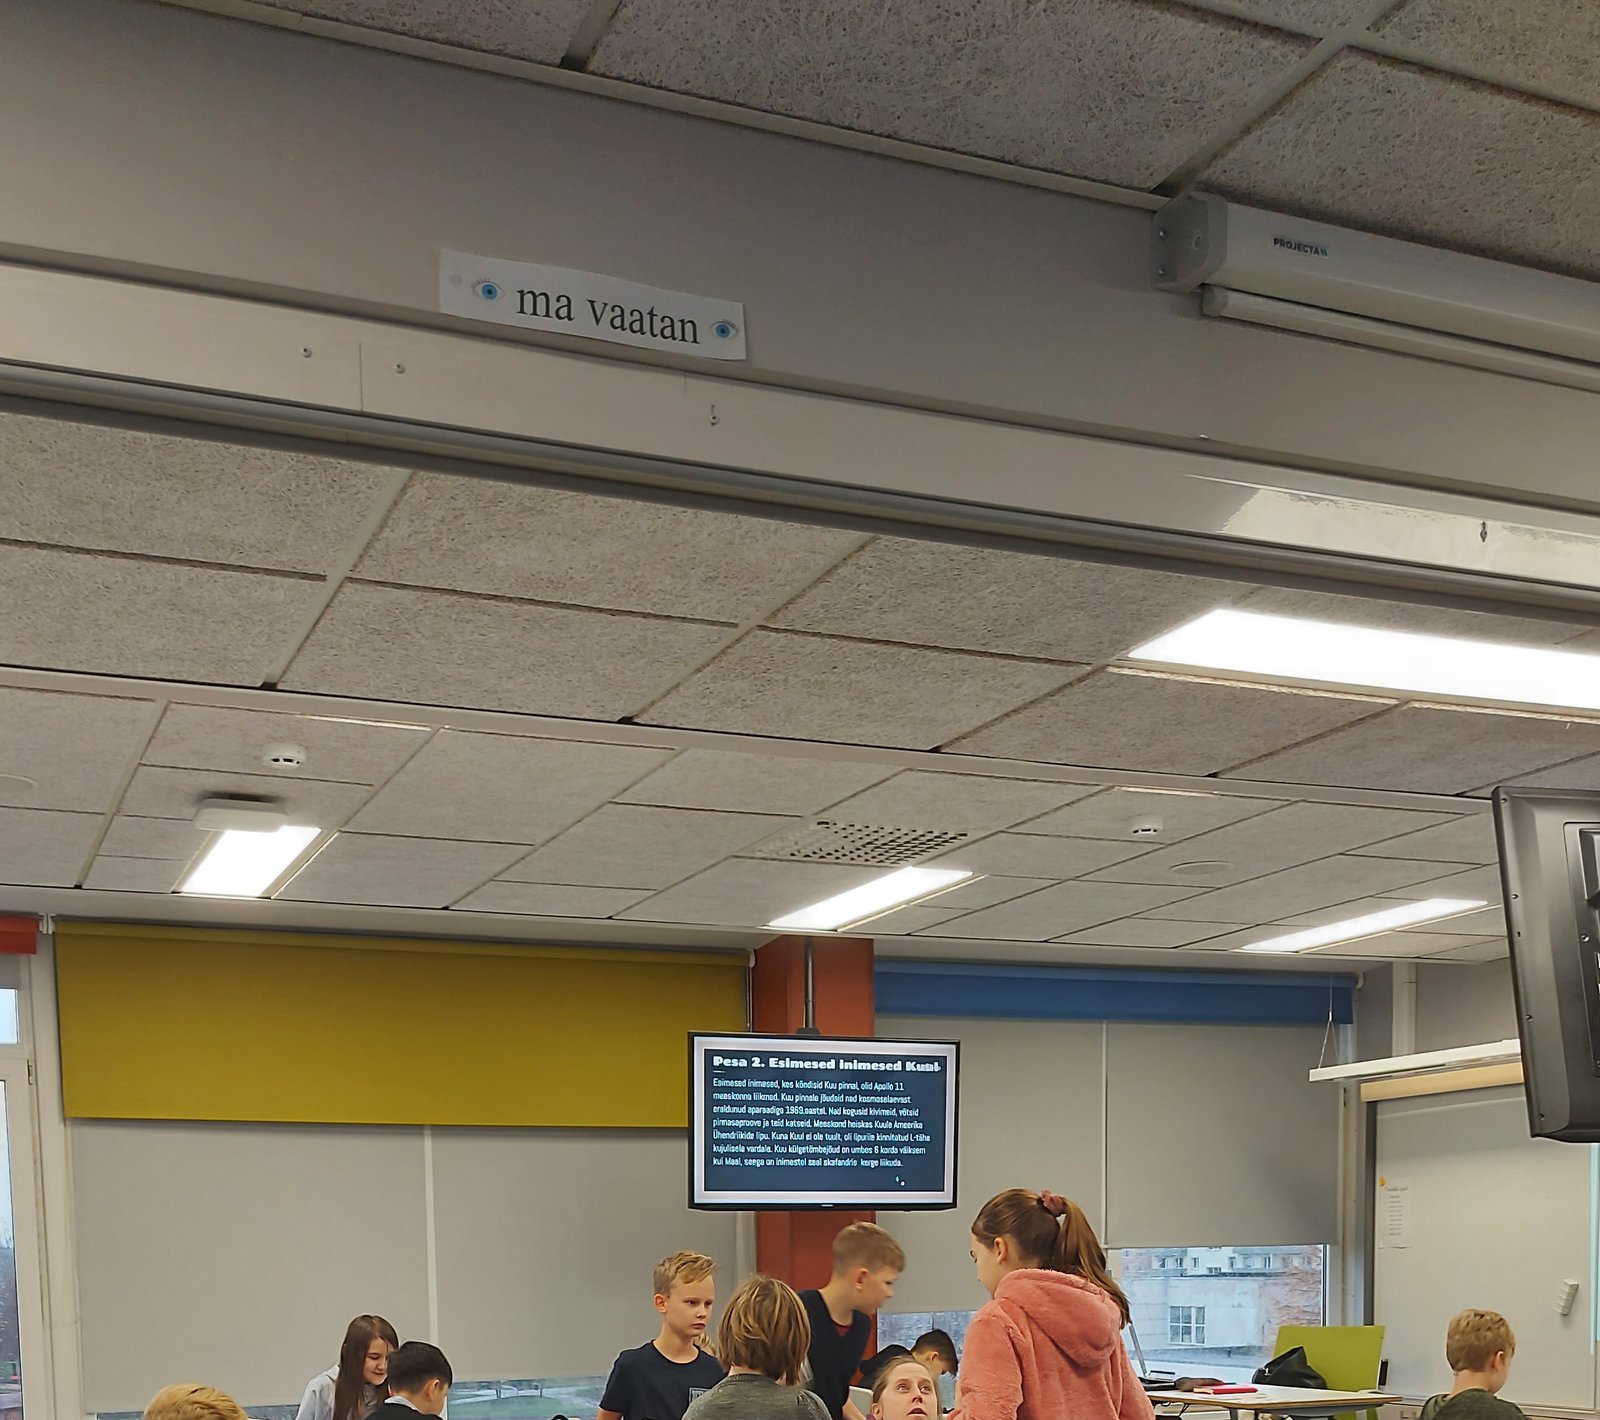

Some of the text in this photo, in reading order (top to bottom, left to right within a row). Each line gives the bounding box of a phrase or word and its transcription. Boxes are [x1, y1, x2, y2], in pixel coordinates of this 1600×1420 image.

[516, 289, 701, 345] ma vaatan
[713, 1056, 748, 1067] Pesa
[751, 1057, 766, 1068] 2.
[769, 1057, 835, 1070] Esimesed
[839, 1059, 902, 1071] inimesed
[713, 1078, 905, 1092] Esimesed inimesed, kes kõndisid Kuu pinnal, olid Apollo 11
[713, 1091, 911, 1104] meeskonna liikmed. Kuu pinnale jõudsid nad kosmoselaevast
[713, 1105, 747, 1114] eraldunud
[747, 1105, 784, 1116] aparaadiga
[828, 1107, 842, 1116] Nad
[842, 1107, 868, 1117] kogusid
[869, 1107, 898, 1117] kivimeid,
[898, 1108, 919, 1117] võtsid
[762, 1118, 770, 1129] ja
[785, 1119, 812, 1128] katseid.
[813, 1119, 847, 1128] Meeskond
[847, 1119, 873, 1129] heiskas
[874, 1120, 893, 1129] Kuule
[893, 1120, 923, 1129] Ameerika
[713, 1129, 755, 1140] Ühendriikide
[755, 1131, 771, 1141] lipu.
[771, 1131, 789, 1141] Kuna
[789, 1131, 805, 1141] Kuul
[805, 1132, 813, 1141] ei
[813, 1132, 824, 1141] ole
[824, 1132, 843, 1142] tuult,
[843, 1132, 853, 1141] oli
[876, 1132, 910, 1142] kinnitatud
[909, 1133, 931, 1142] L-tähe
[713, 1143, 746, 1154] kujulisele
[746, 1144, 773, 1153] vardale.
[774, 1144, 788, 1153] Kuu
[841, 1146, 850, 1154] on
[850, 1145, 873, 1154] umbes
[873, 1145, 880, 1154] 6
[880, 1145, 899, 1154] korda
[899, 1145, 926, 1155] väiksem
[713, 1156, 724, 1166] kui
[724, 1157, 743, 1167] Maal,
[743, 1158, 765, 1168] seega
[765, 1158, 775, 1166] on
[775, 1157, 807, 1167] inimestel
[823, 1157, 858, 1167] skafandris
[860, 1158, 879, 1168] kerge
[879, 1158, 904, 1167] liikuda.
